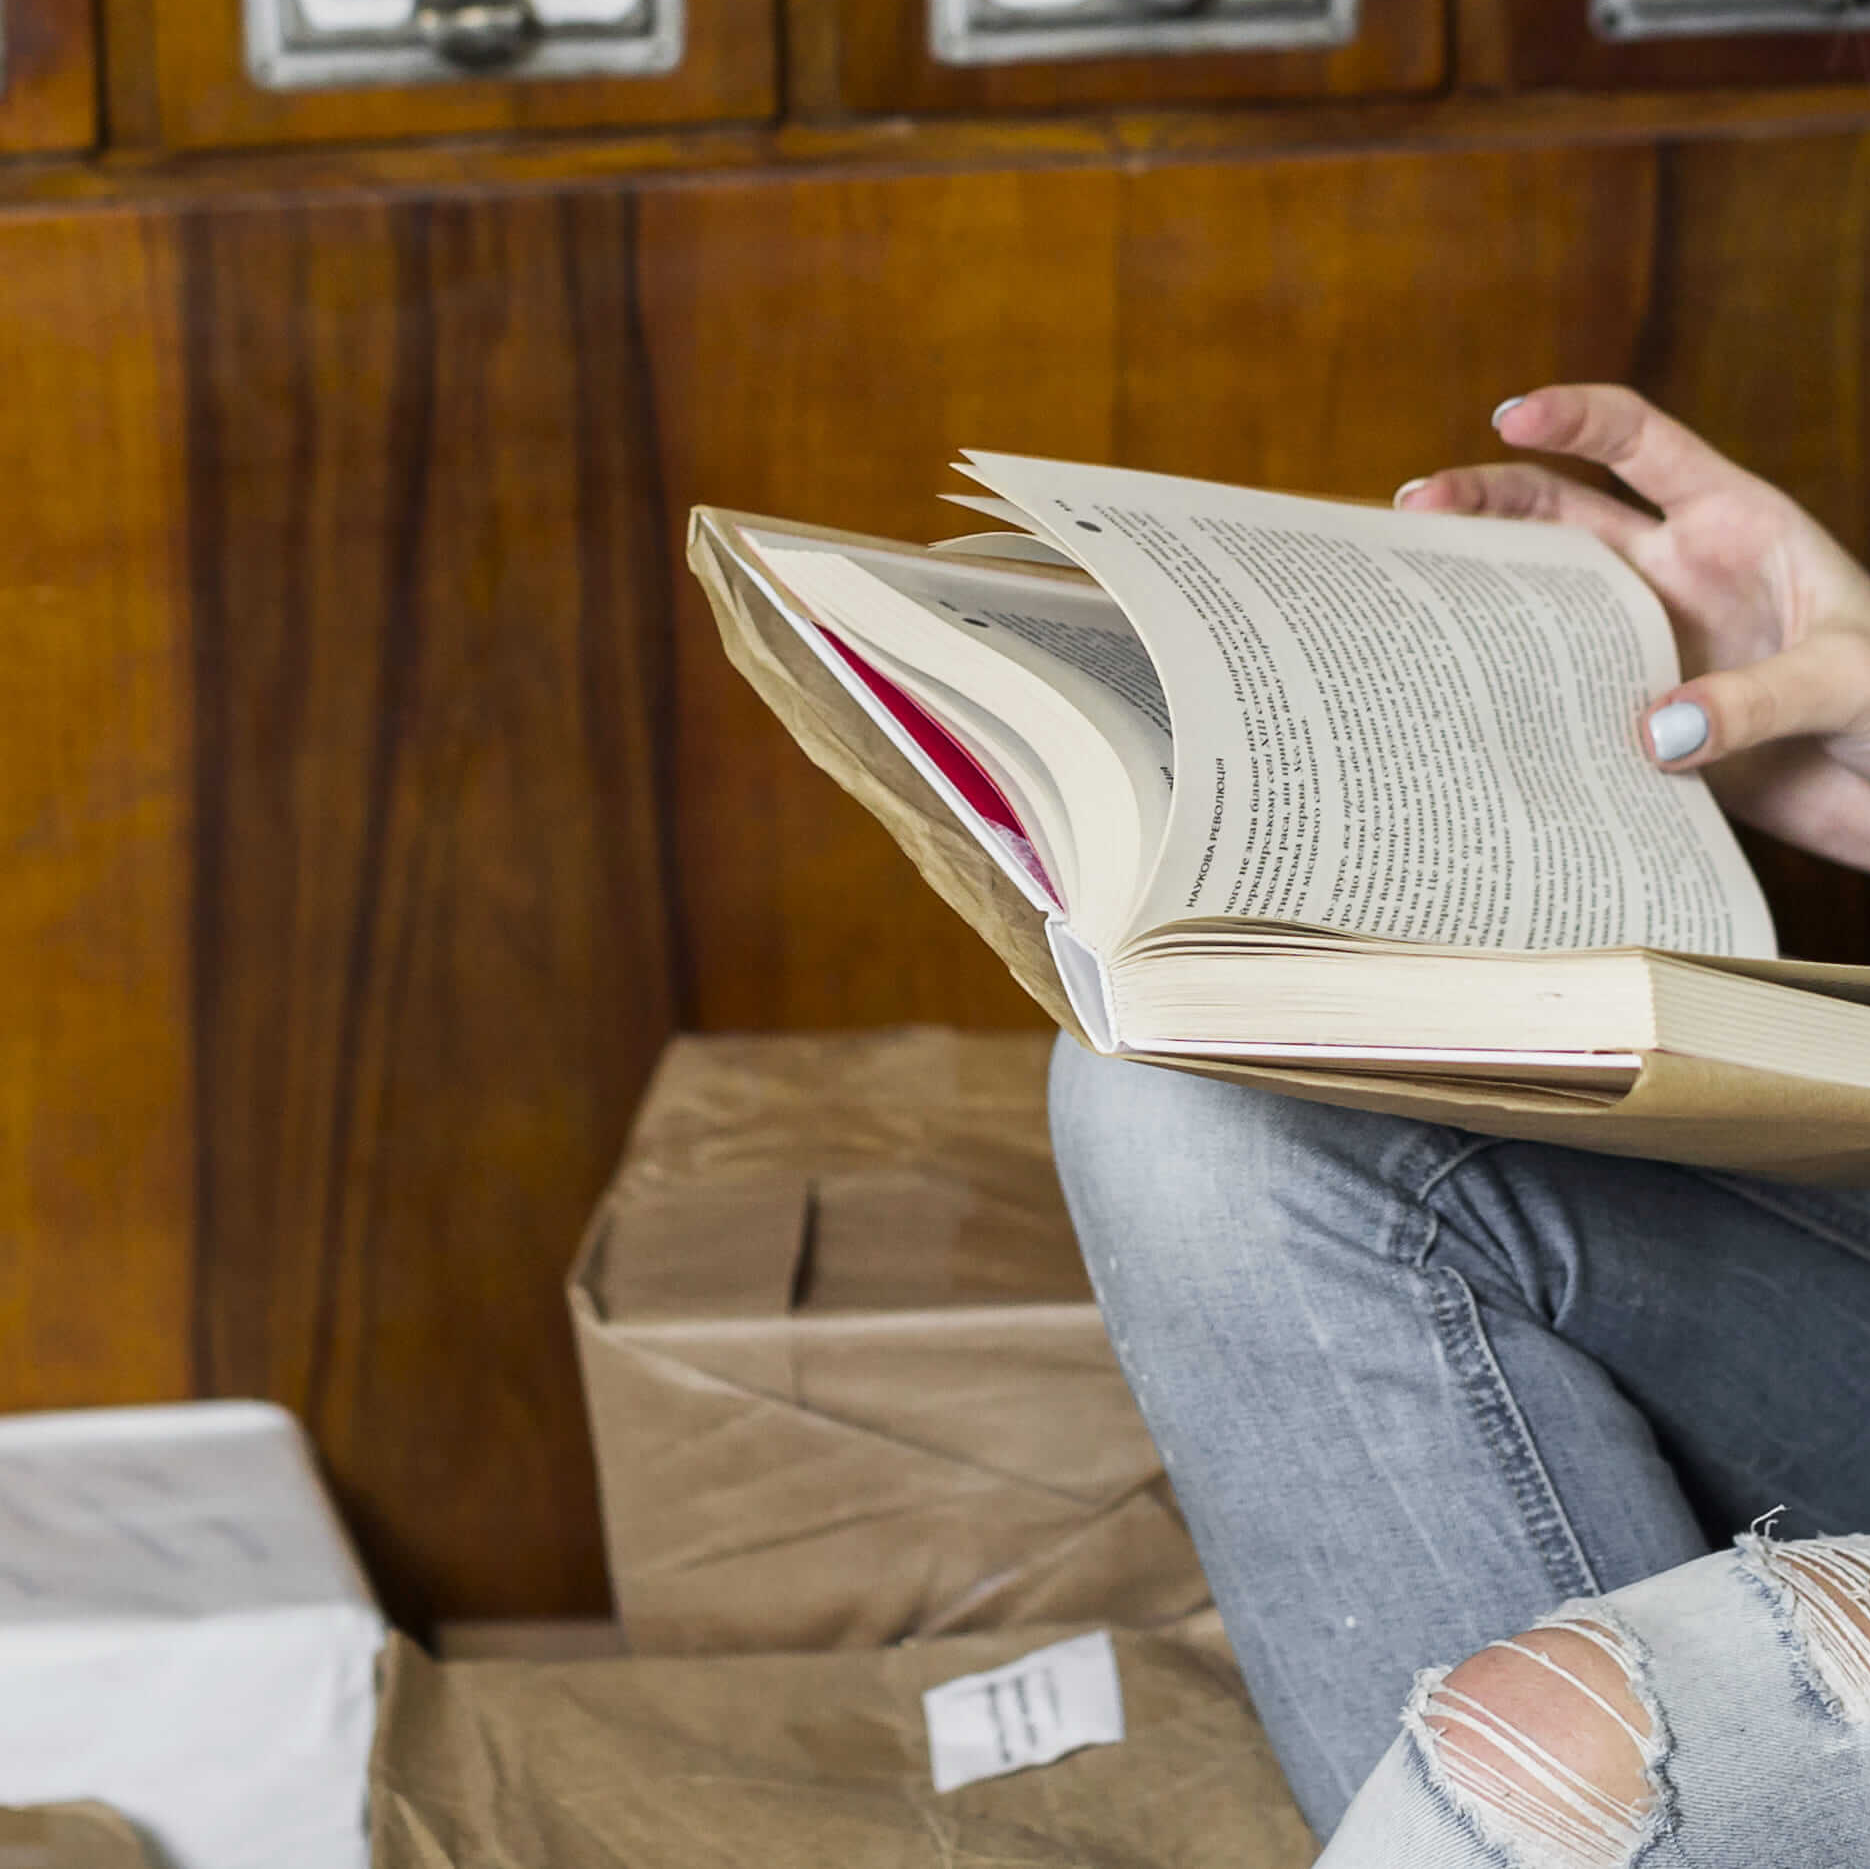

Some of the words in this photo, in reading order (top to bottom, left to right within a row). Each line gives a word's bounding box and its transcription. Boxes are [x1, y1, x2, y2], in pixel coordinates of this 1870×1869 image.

[1186, 839, 1217, 908] НАУКОВА
[1209, 757, 1226, 841] РЕВОЛЮЦІЯ
[1238, 857, 1250, 875] не
[1250, 756, 1260, 813] більше
[1278, 812, 1291, 851] раса,
[1282, 782, 1291, 806] він
[1242, 790, 1275, 915] йоркширському
[1294, 891, 1307, 916] ати
[1303, 807, 1321, 887] місцевого
[1380, 782, 1398, 901] йоркширський
[1427, 870, 1439, 891] Це
[1348, 874, 1360, 899] що
[1434, 879, 1453, 936] коріше,
